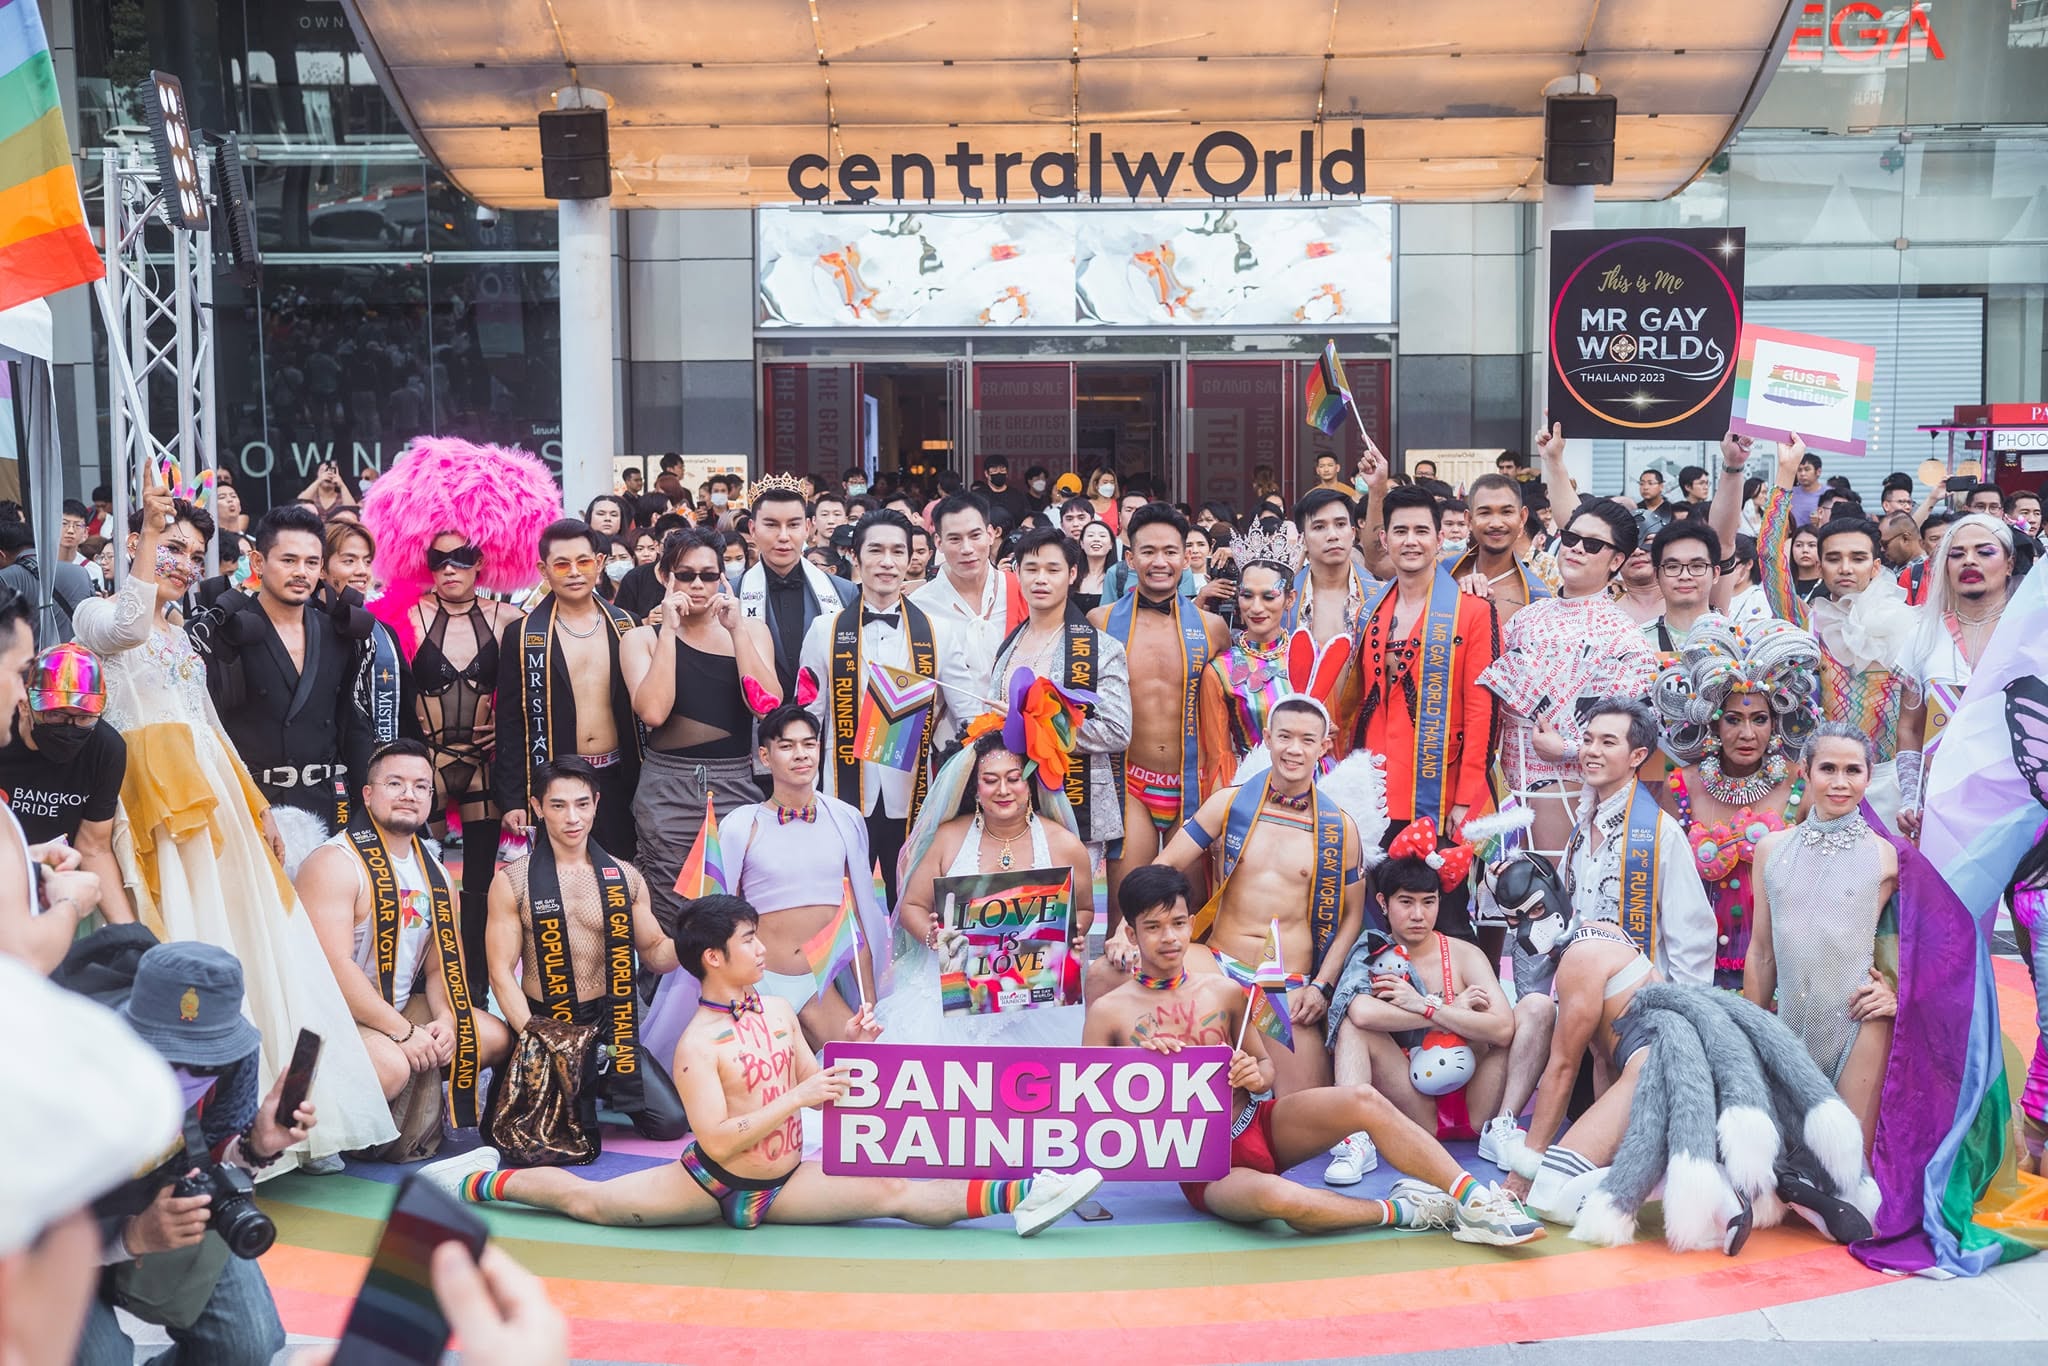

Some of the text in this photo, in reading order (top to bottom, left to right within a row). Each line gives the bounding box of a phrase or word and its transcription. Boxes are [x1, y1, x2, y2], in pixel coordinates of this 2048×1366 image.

[788, 128, 1366, 199] centralwOrld
[1598, 264, 1684, 294] This is Me
[1581, 307, 1707, 331] MR GAY
[1577, 334, 1702, 362] WORLD
[1580, 373, 1665, 382] THAILAND 2023
[1207, 414, 1238, 466] THE
[747, 607, 757, 617] M
[1072, 637, 1091, 657] MR
[1431, 622, 1447, 642] MR
[917, 653, 933, 674] MR
[1192, 646, 1204, 673] THE
[1429, 644, 1445, 667] GAY
[1071, 663, 1091, 686] GAY
[1539, 659, 1566, 691] FRAGILE
[836, 677, 854, 739] RUNNER
[1187, 677, 1199, 737] WINNER
[1426, 671, 1443, 716] WORLD
[838, 745, 855, 766] UP
[1421, 719, 1440, 779] THAILAND
[1065, 757, 1084, 806] AILAND
[12, 800, 59, 817] PRIDE
[338, 802, 349, 823] MR
[1324, 823, 1339, 844] MR
[1323, 847, 1338, 872] GAY
[362, 847, 395, 974] POPULAR VOTE
[436, 900, 450, 923] MR
[606, 885, 625, 908] MR
[955, 894, 1060, 930] LOVE
[1317, 876, 1337, 920] WORLD
[1629, 871, 1647, 932] RUNNER
[440, 928, 457, 955] GAY
[609, 914, 629, 939] GAY
[997, 931, 1019, 951] IS
[539, 918, 573, 1024] POPULAR VO
[612, 945, 631, 997] WORLD
[976, 951, 1045, 976] LOVE
[446, 961, 468, 1011] WORLD
[732, 1013, 772, 1051] MY
[1156, 1000, 1195, 1037] MY
[457, 1016, 473, 1089] THAILAND
[613, 1003, 635, 1074] THAILAND
[742, 1046, 795, 1094] BODY
[833, 1058, 1224, 1113] BANGKOK
[1232, 1103, 1255, 1138] RUCTURE
[840, 1113, 1208, 1168] RAINBOW
